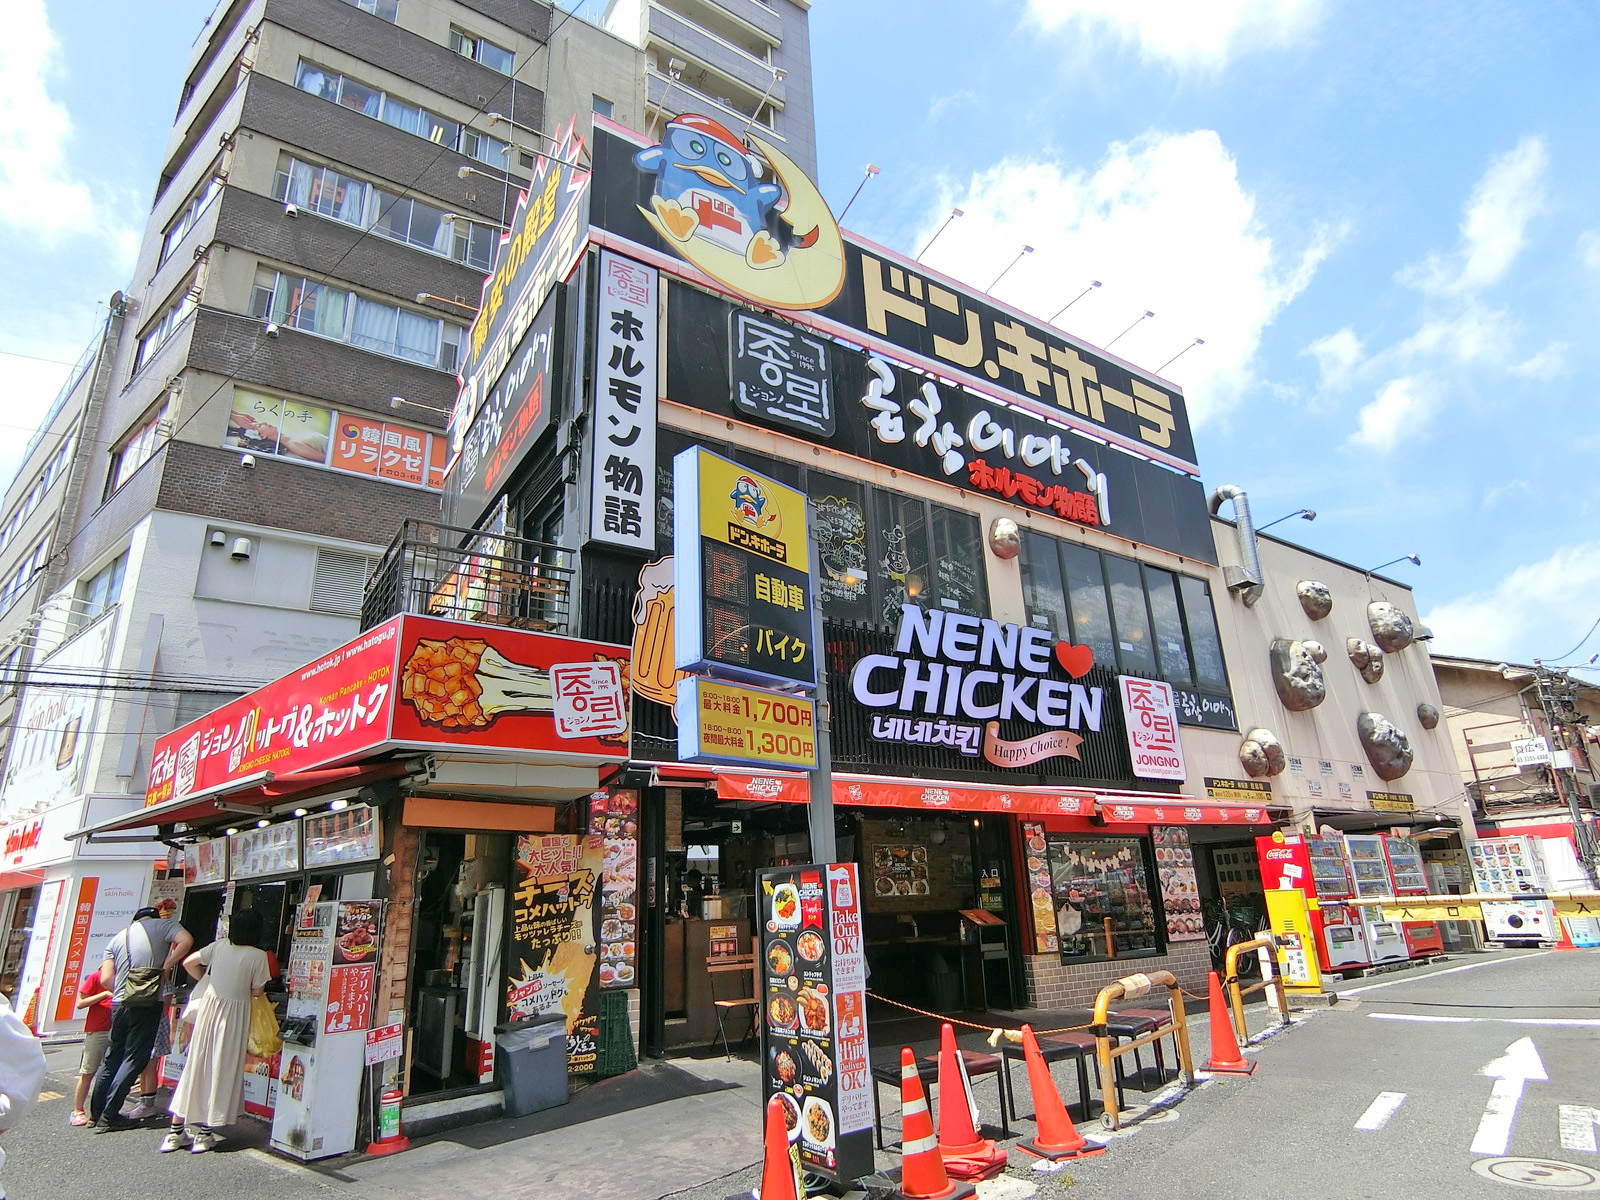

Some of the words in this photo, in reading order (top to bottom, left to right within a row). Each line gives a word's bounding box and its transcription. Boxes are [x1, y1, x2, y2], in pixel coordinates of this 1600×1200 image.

[252, 400, 313, 424] らくの手
[603, 309, 645, 540] ホルモン物語
[361, 426, 422, 454] 韓国風
[966, 458, 1099, 526] ホルモン物語
[754, 573, 806, 612] 自動車
[755, 628, 807, 664] バイク
[895, 603, 1053, 674] NENE
[561, 673, 618, 726] 종로
[850, 653, 1104, 733] CHICKEN
[702, 699, 741, 716] 最大料金
[741, 696, 813, 728] 1,700円
[1130, 687, 1173, 744] 종로
[702, 732, 745, 748] 夜間最大料金
[746, 729, 815, 759] 1,300円
[872, 716, 982, 756] 네네치킨
[993, 742, 1028, 763] Happy
[1029, 737, 1063, 757] Choice
[1136, 753, 1180, 769] JONGNO
[151, 745, 177, 788] 元祖
[746, 783, 783, 793] CHICKEN
[751, 777, 776, 785] NENE
[147, 781, 174, 809] 日本一号店
[920, 793, 950, 802] CHICKEN
[528, 845, 583, 864] 大ヒット!!
[534, 860, 577, 876] 大人気!
[981, 868, 999, 878] 入口
[513, 868, 596, 907] チーズ
[798, 888, 824, 897] CHICKEN
[802, 882, 819, 890] NENE
[832, 910, 859, 925] Take
[835, 923, 858, 938] Out
[61, 902, 92, 996] 韓国コスメ専門店
[834, 937, 860, 956] OK!
[346, 967, 359, 1011] やってます
[356, 965, 373, 1028] デリバリー
[509, 981, 542, 1001] ジャンボ
[839, 1039, 866, 1061] 出前
[840, 1061, 867, 1072] Delivery
[841, 1069, 867, 1092] OK!
[841, 1093, 869, 1104] デリバリー
[841, 1100, 869, 1114] やってます
